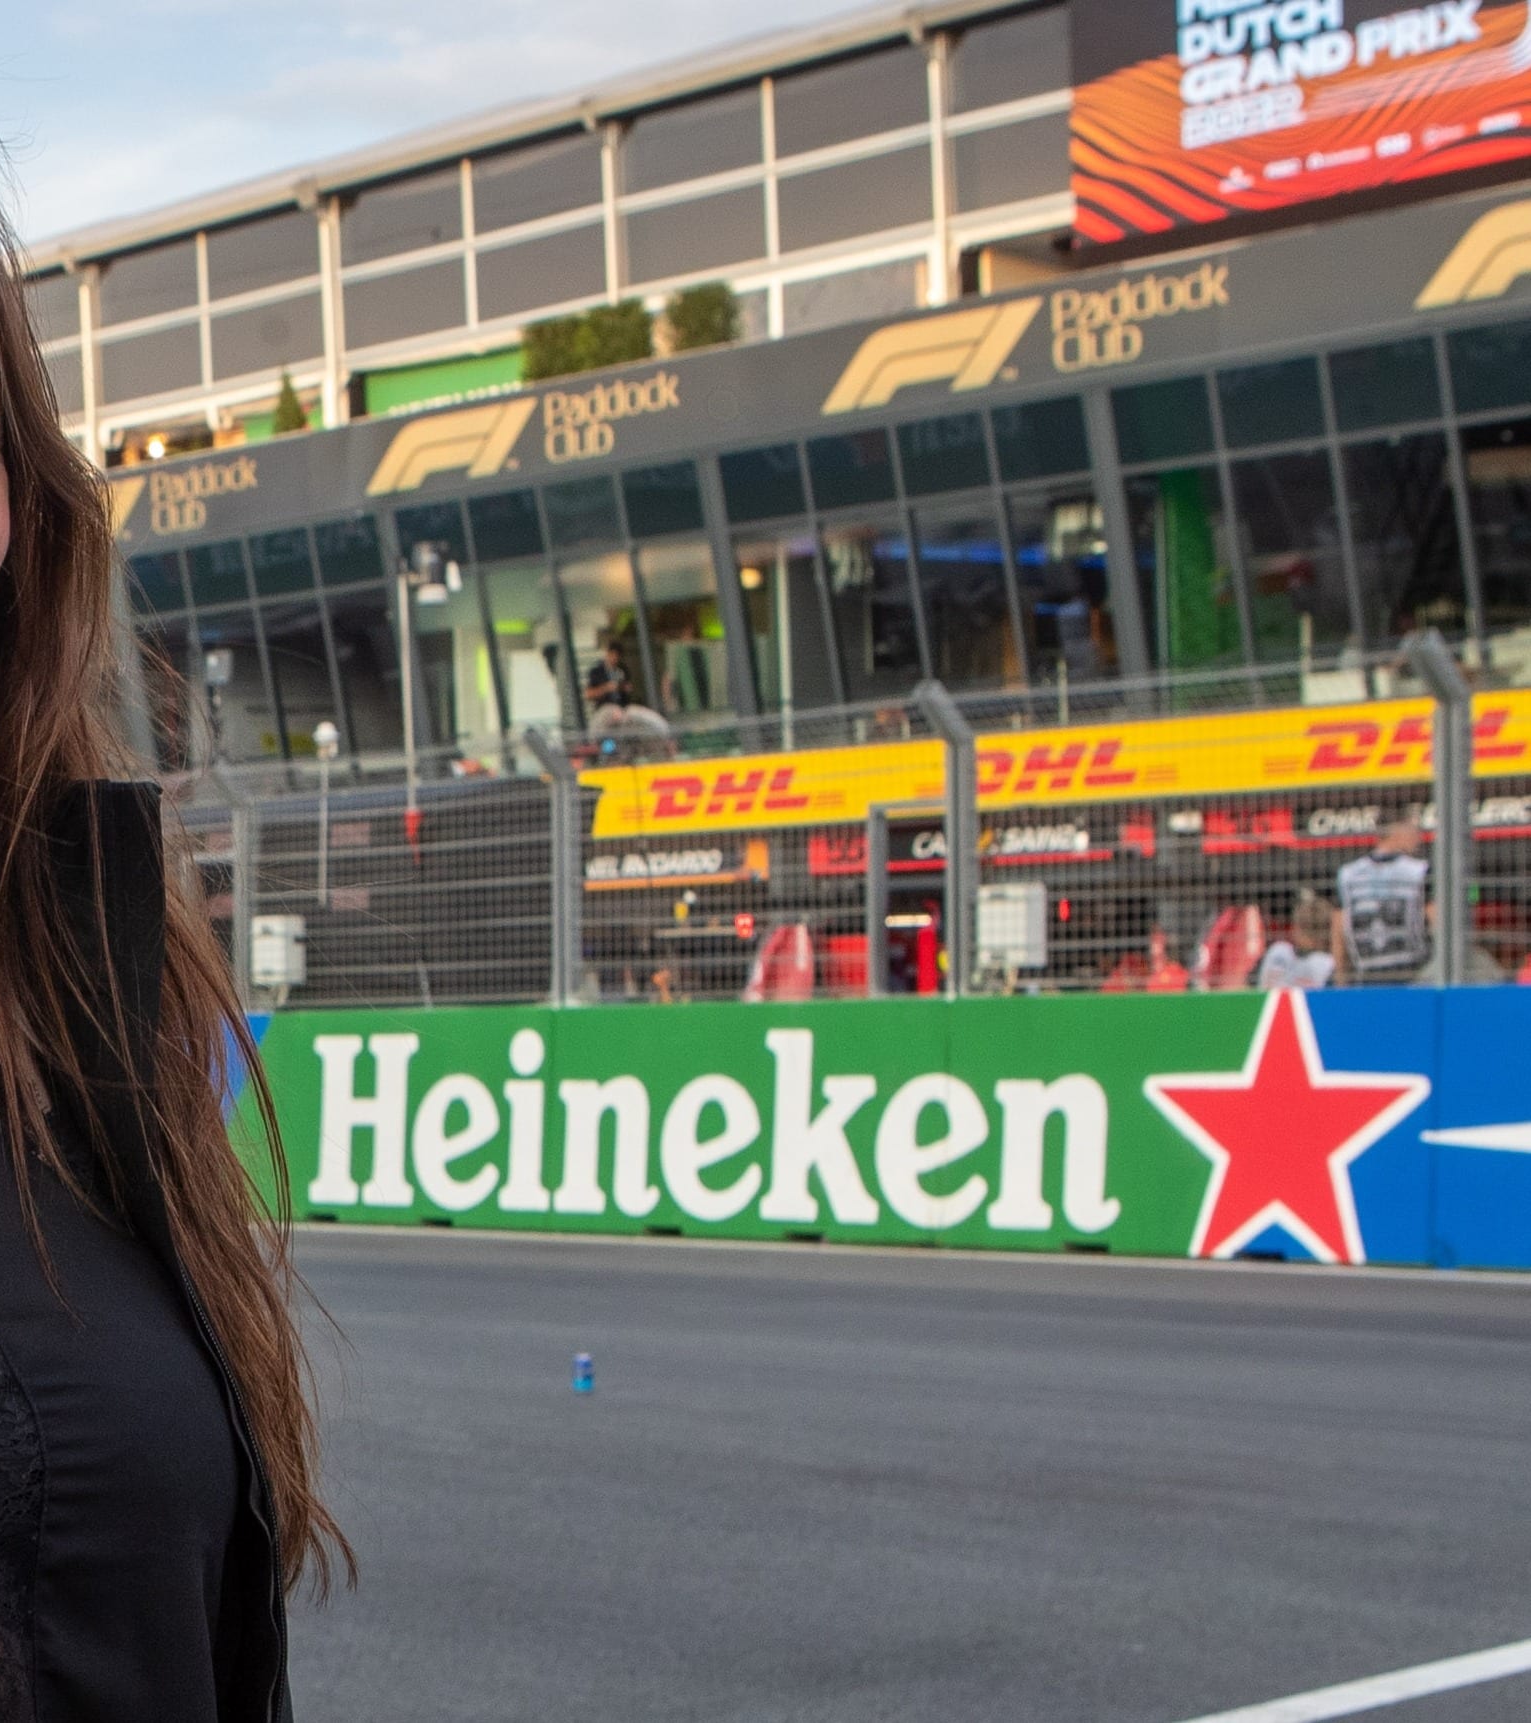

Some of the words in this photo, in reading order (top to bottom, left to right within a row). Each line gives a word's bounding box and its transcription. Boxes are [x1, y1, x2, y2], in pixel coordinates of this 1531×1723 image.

[1178, 0, 1344, 67] DUTCH
[1179, 29, 1356, 107] GRAND
[1355, 0, 1483, 68] PRIX
[1050, 262, 1230, 334] Paddock
[1052, 321, 1143, 373] Club
[544, 370, 680, 430] Paddock
[545, 421, 615, 464] Club
[150, 456, 258, 503] Paddock
[152, 497, 208, 536] Club
[976, 739, 1137, 795] DHL
[1305, 709, 1527, 773] DHL
[649, 767, 810, 819] DHL
[1307, 805, 1381, 836] CHAR
[308, 1027, 1121, 1233] Heineken
